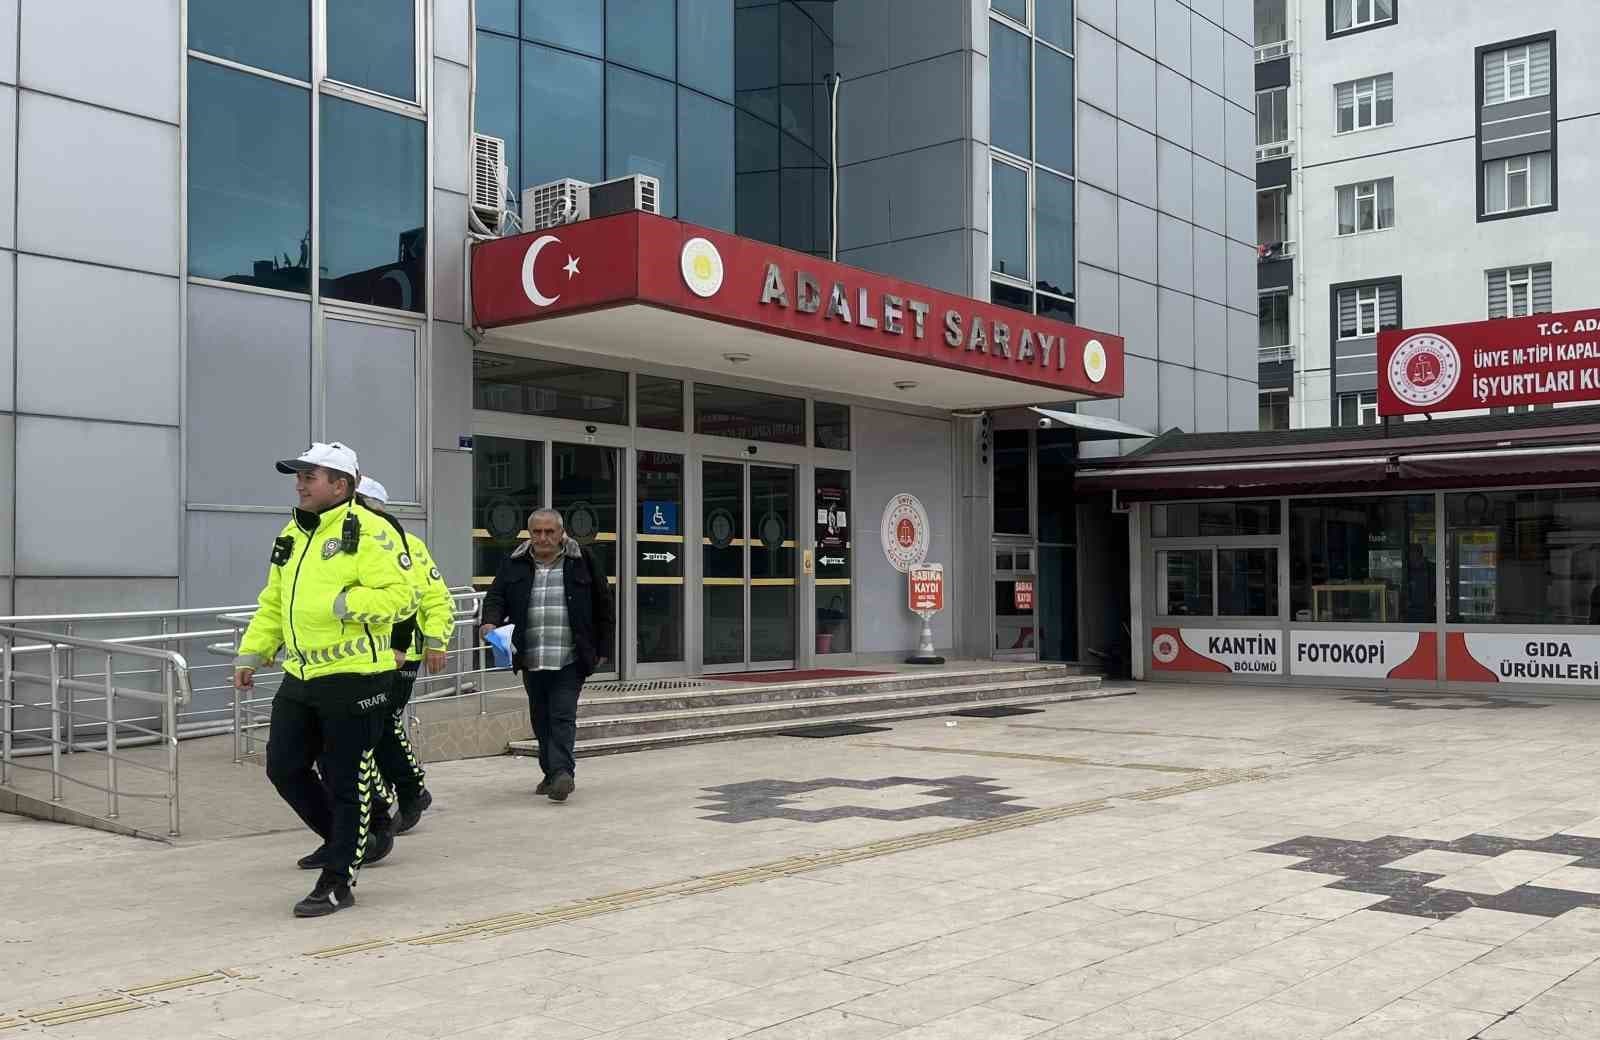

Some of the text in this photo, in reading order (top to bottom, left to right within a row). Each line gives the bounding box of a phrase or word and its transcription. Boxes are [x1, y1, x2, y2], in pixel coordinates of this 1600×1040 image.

[759, 263, 1066, 370] ADALET SARAYI
[1537, 318, 1600, 336] T.C. AD
[1474, 349, 1509, 369] ÜNYE
[1512, 343, 1553, 365] M-TİPİ
[1473, 369, 1574, 403] İŞYURTLARI
[914, 583, 939, 593] KAYDI
[1209, 633, 1276, 655] KANTİN
[1298, 640, 1385, 664] FOTOKOPİ
[1525, 642, 1572, 657] GIDA
[1234, 661, 1277, 672] BÖLÜMÜ
[1500, 659, 1599, 680] ÜRÜNLERİ
